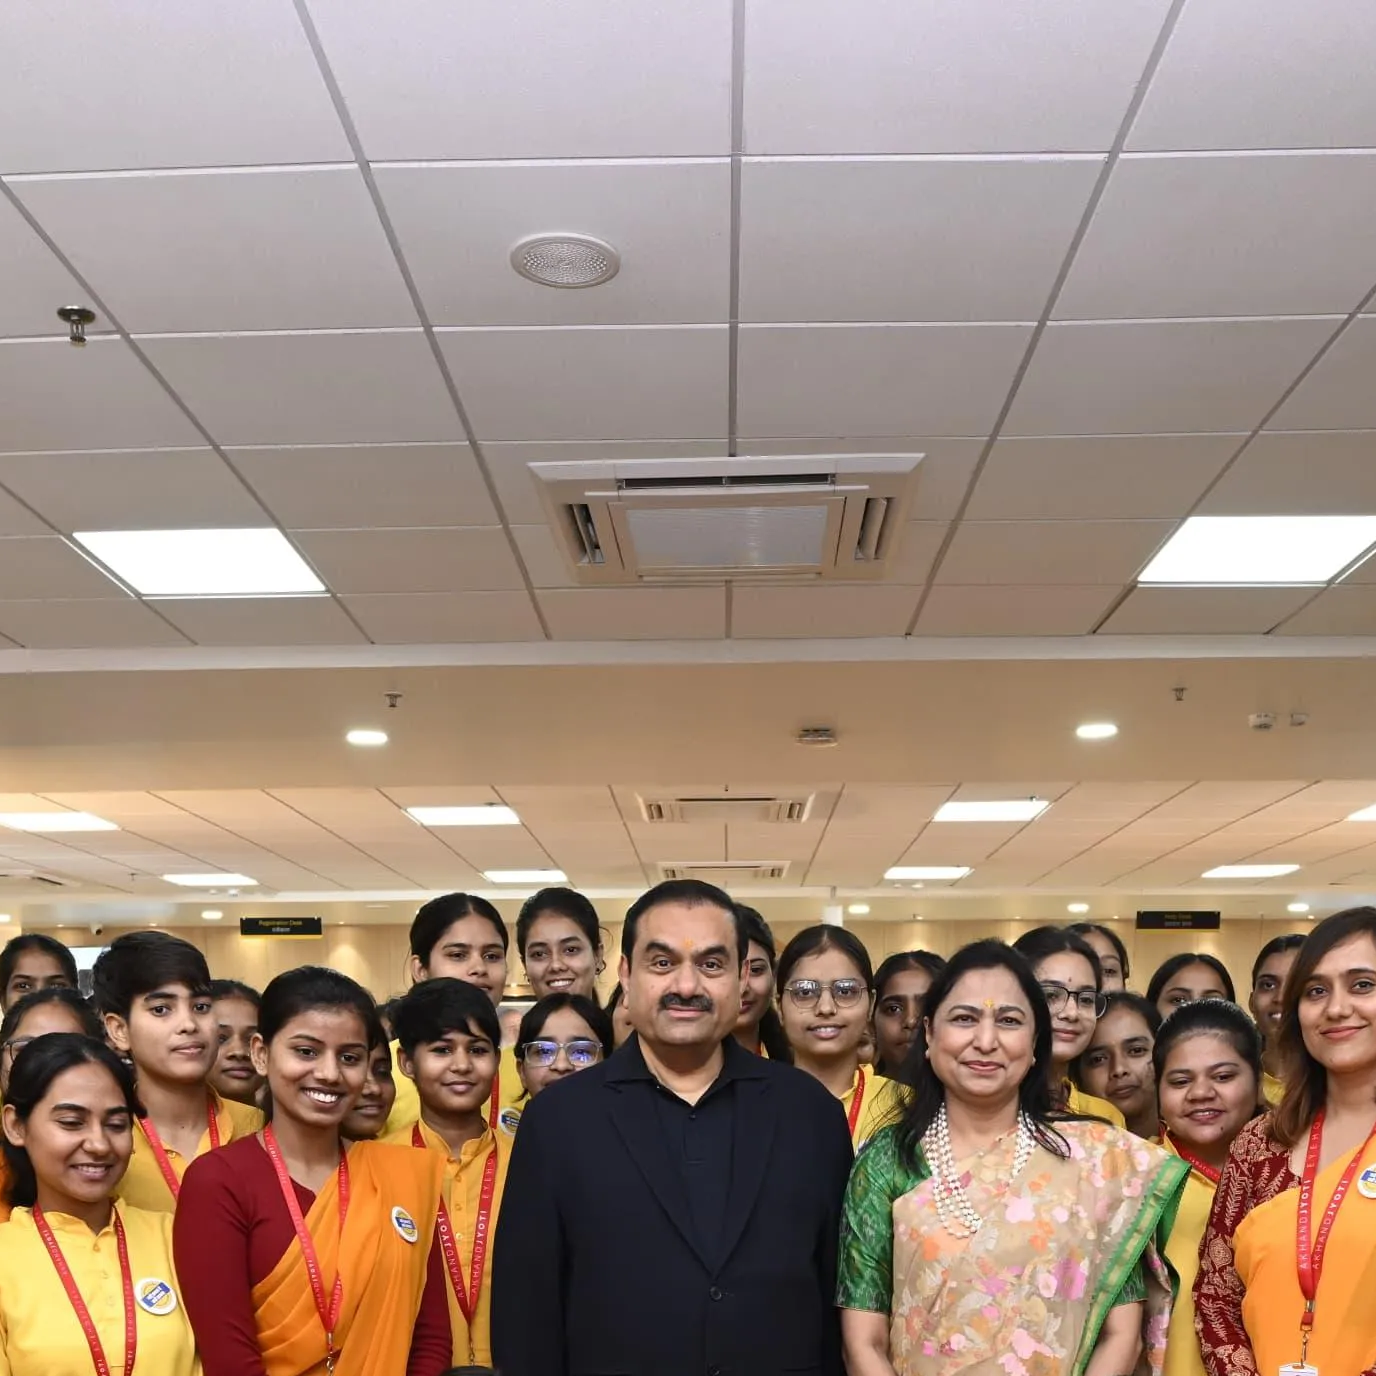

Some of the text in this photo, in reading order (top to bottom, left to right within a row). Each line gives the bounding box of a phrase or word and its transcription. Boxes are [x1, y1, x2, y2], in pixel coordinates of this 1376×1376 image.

[436, 1211, 464, 1299] AKHANDJYOTI
[472, 1210, 489, 1295] AKHANDJYOTI
[1299, 1179, 1312, 1270] AKHANDJYOTI
[1312, 1179, 1350, 1270] AKHANDJYOTI
